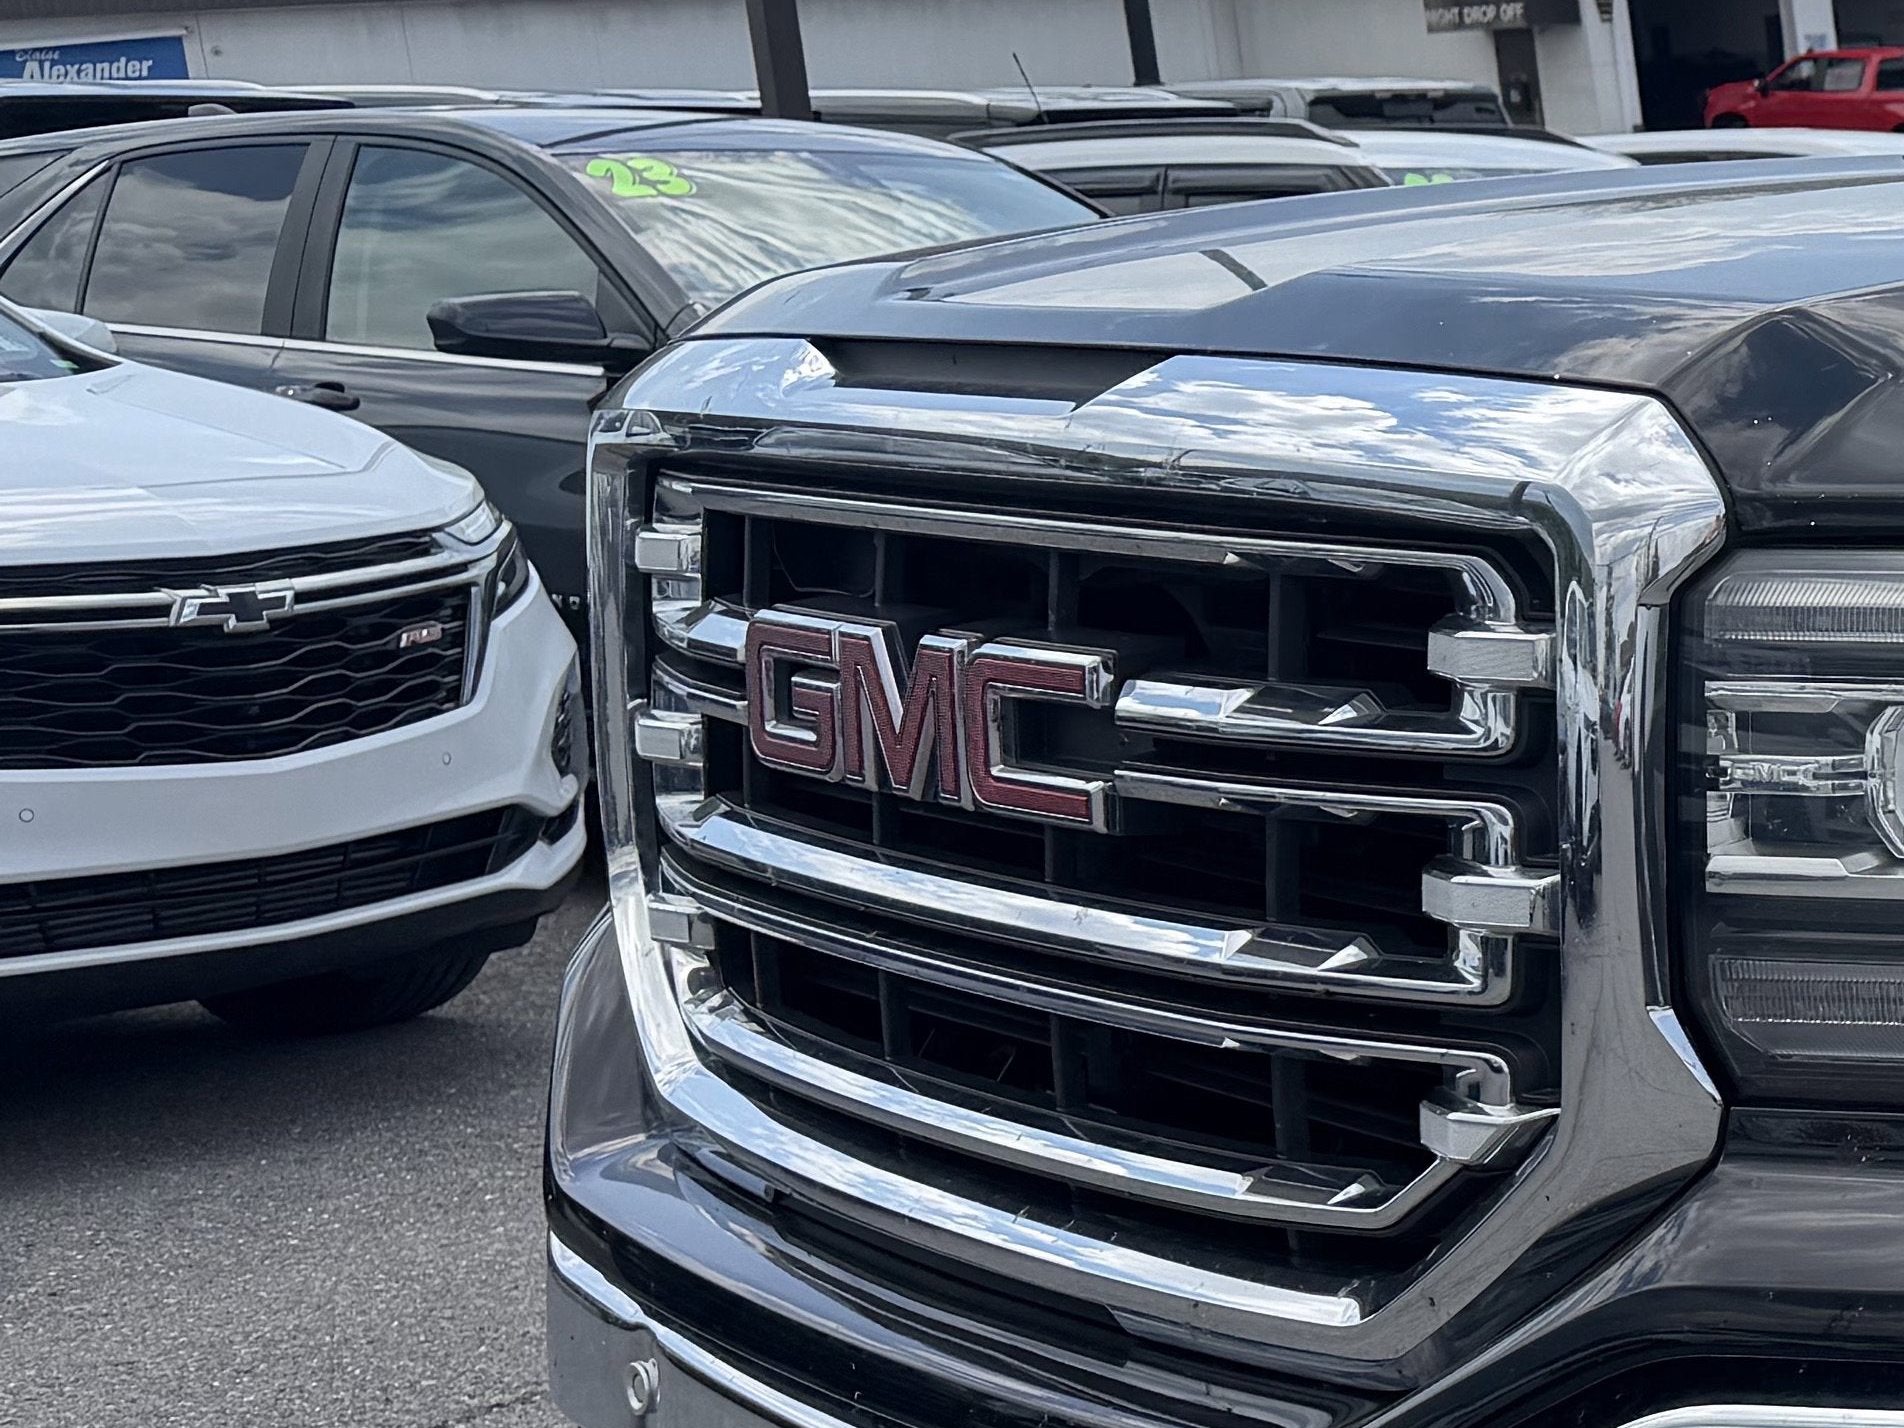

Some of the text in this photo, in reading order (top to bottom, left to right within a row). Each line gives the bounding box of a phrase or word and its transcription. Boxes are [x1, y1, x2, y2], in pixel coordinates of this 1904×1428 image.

[22, 57, 153, 84] Alexander
[585, 156, 697, 197] 23
[744, 607, 1113, 834] GMC
